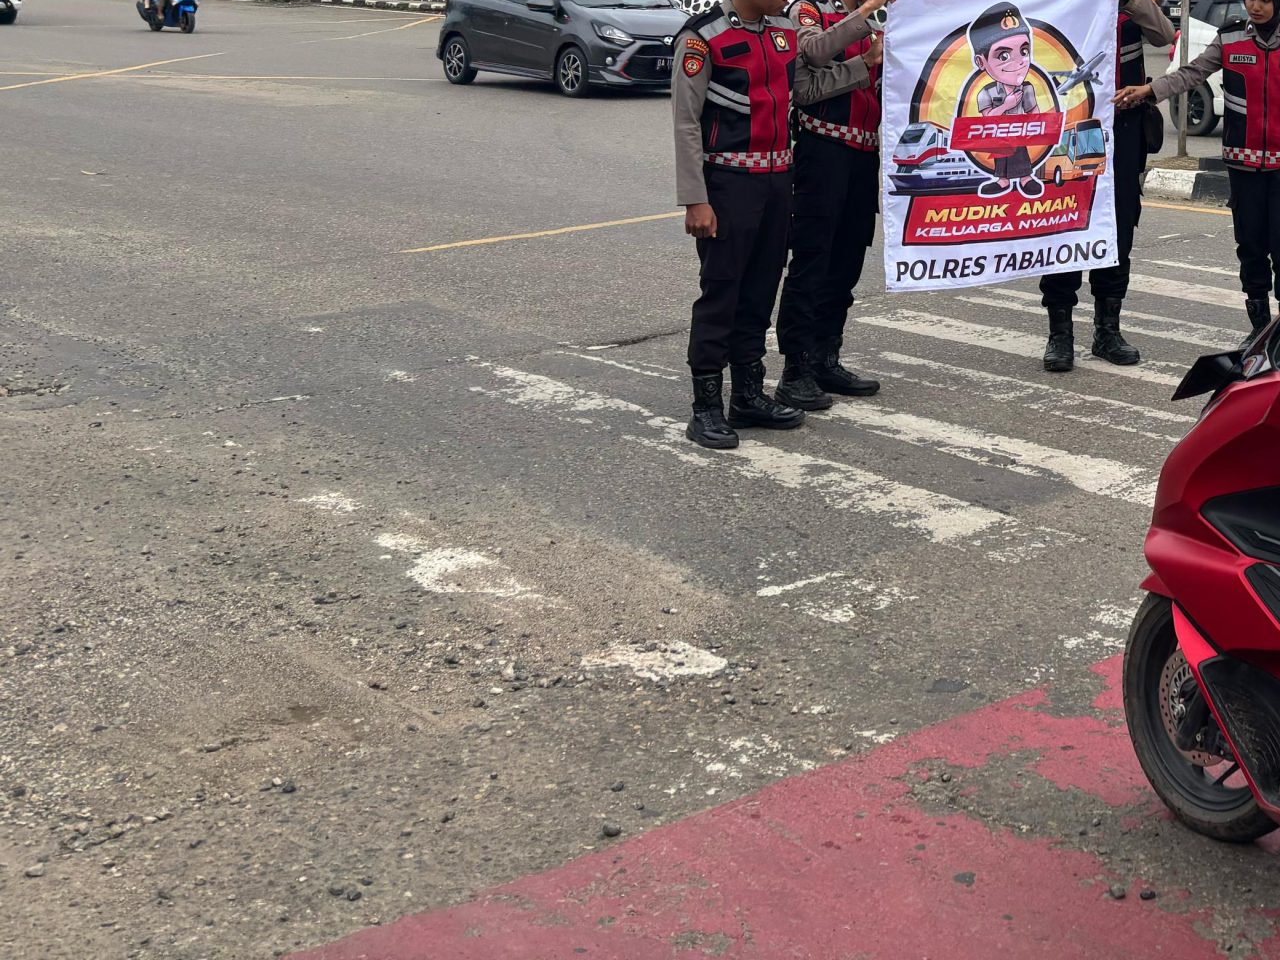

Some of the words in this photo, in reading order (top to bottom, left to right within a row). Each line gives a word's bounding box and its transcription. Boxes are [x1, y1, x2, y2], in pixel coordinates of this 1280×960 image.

[967, 120, 1046, 140] PRESISI
[925, 203, 1009, 223] MUDIK
[1016, 194, 1078, 217] AMAN,
[915, 222, 1014, 237] KELUARGA
[1018, 211, 1079, 230] NYAMAN
[896, 255, 987, 282] POLRES
[994, 239, 1107, 273] TABALONG
